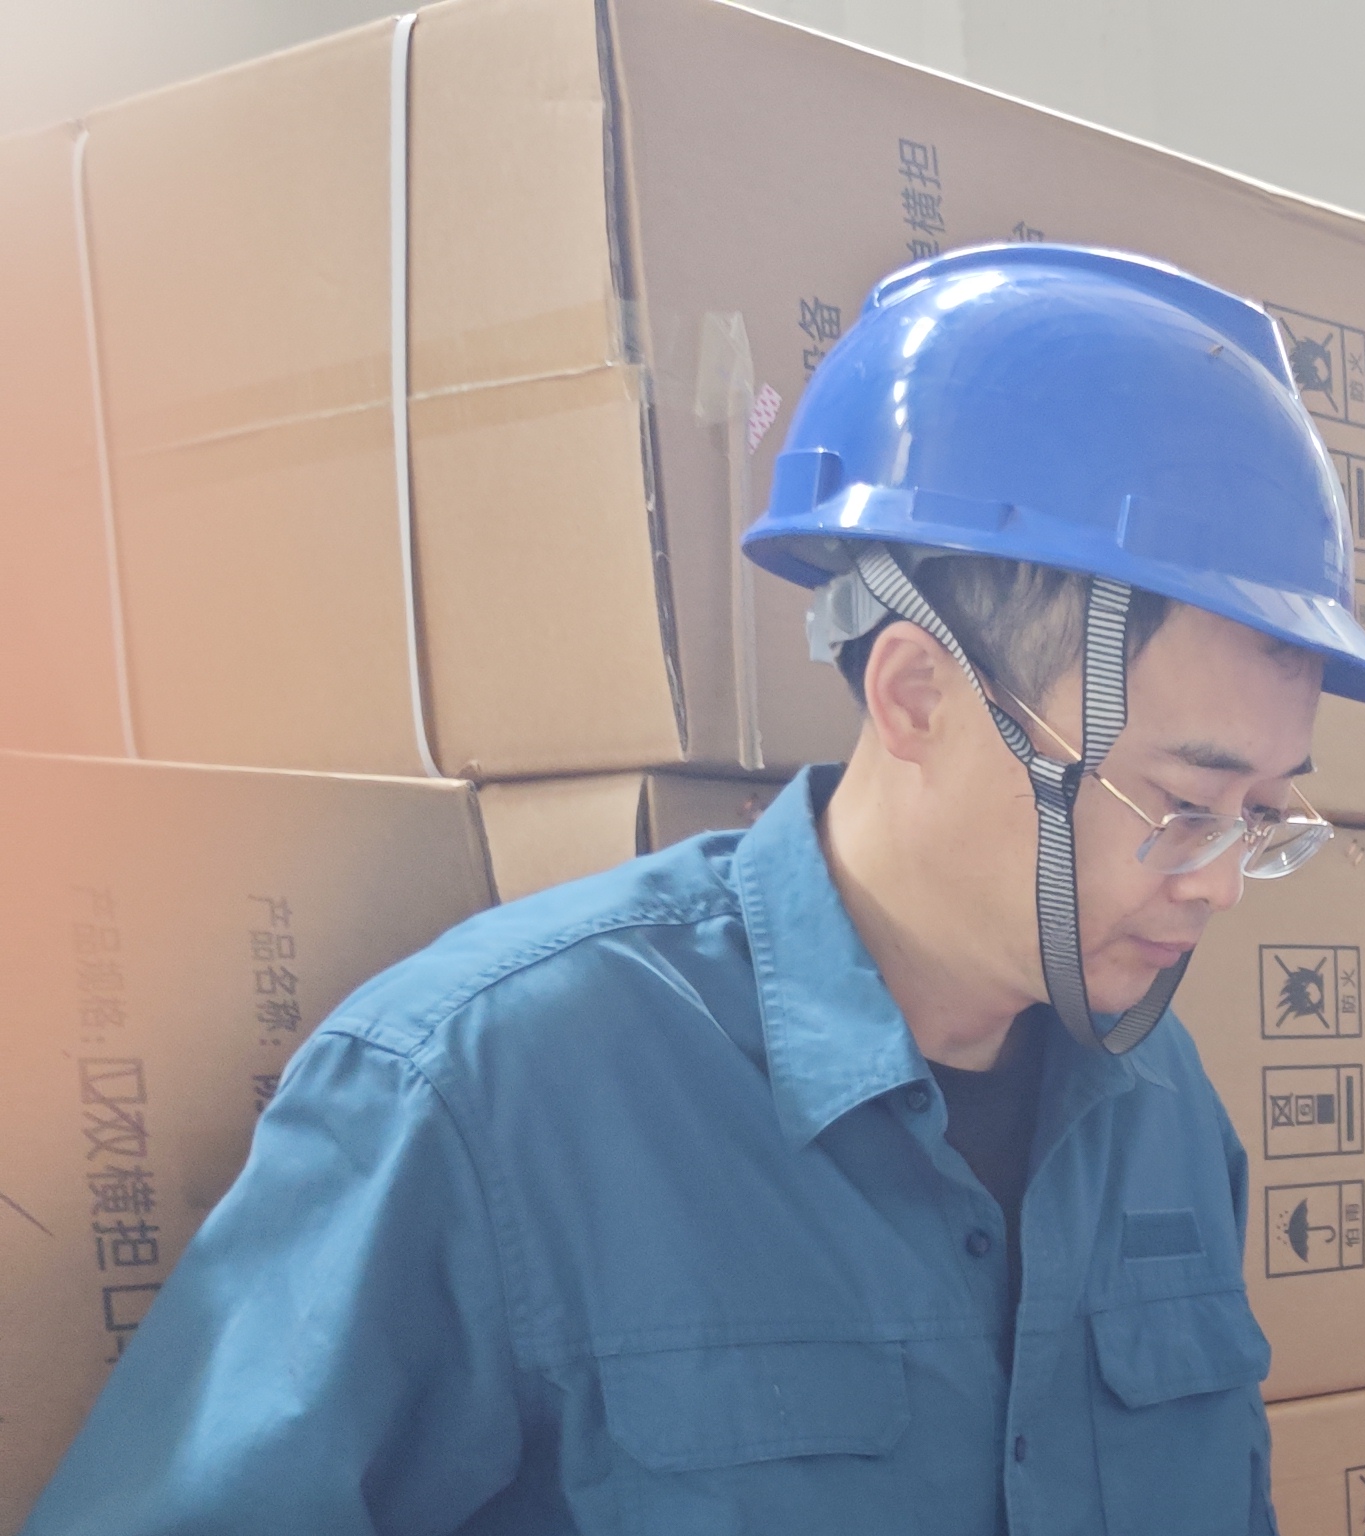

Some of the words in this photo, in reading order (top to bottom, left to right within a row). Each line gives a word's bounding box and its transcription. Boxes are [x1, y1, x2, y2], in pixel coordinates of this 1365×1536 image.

[1340, 968, 1357, 1015] 防火
[82, 1110, 161, 1271] 双横担
[1344, 1202, 1361, 1248] 怕雨
